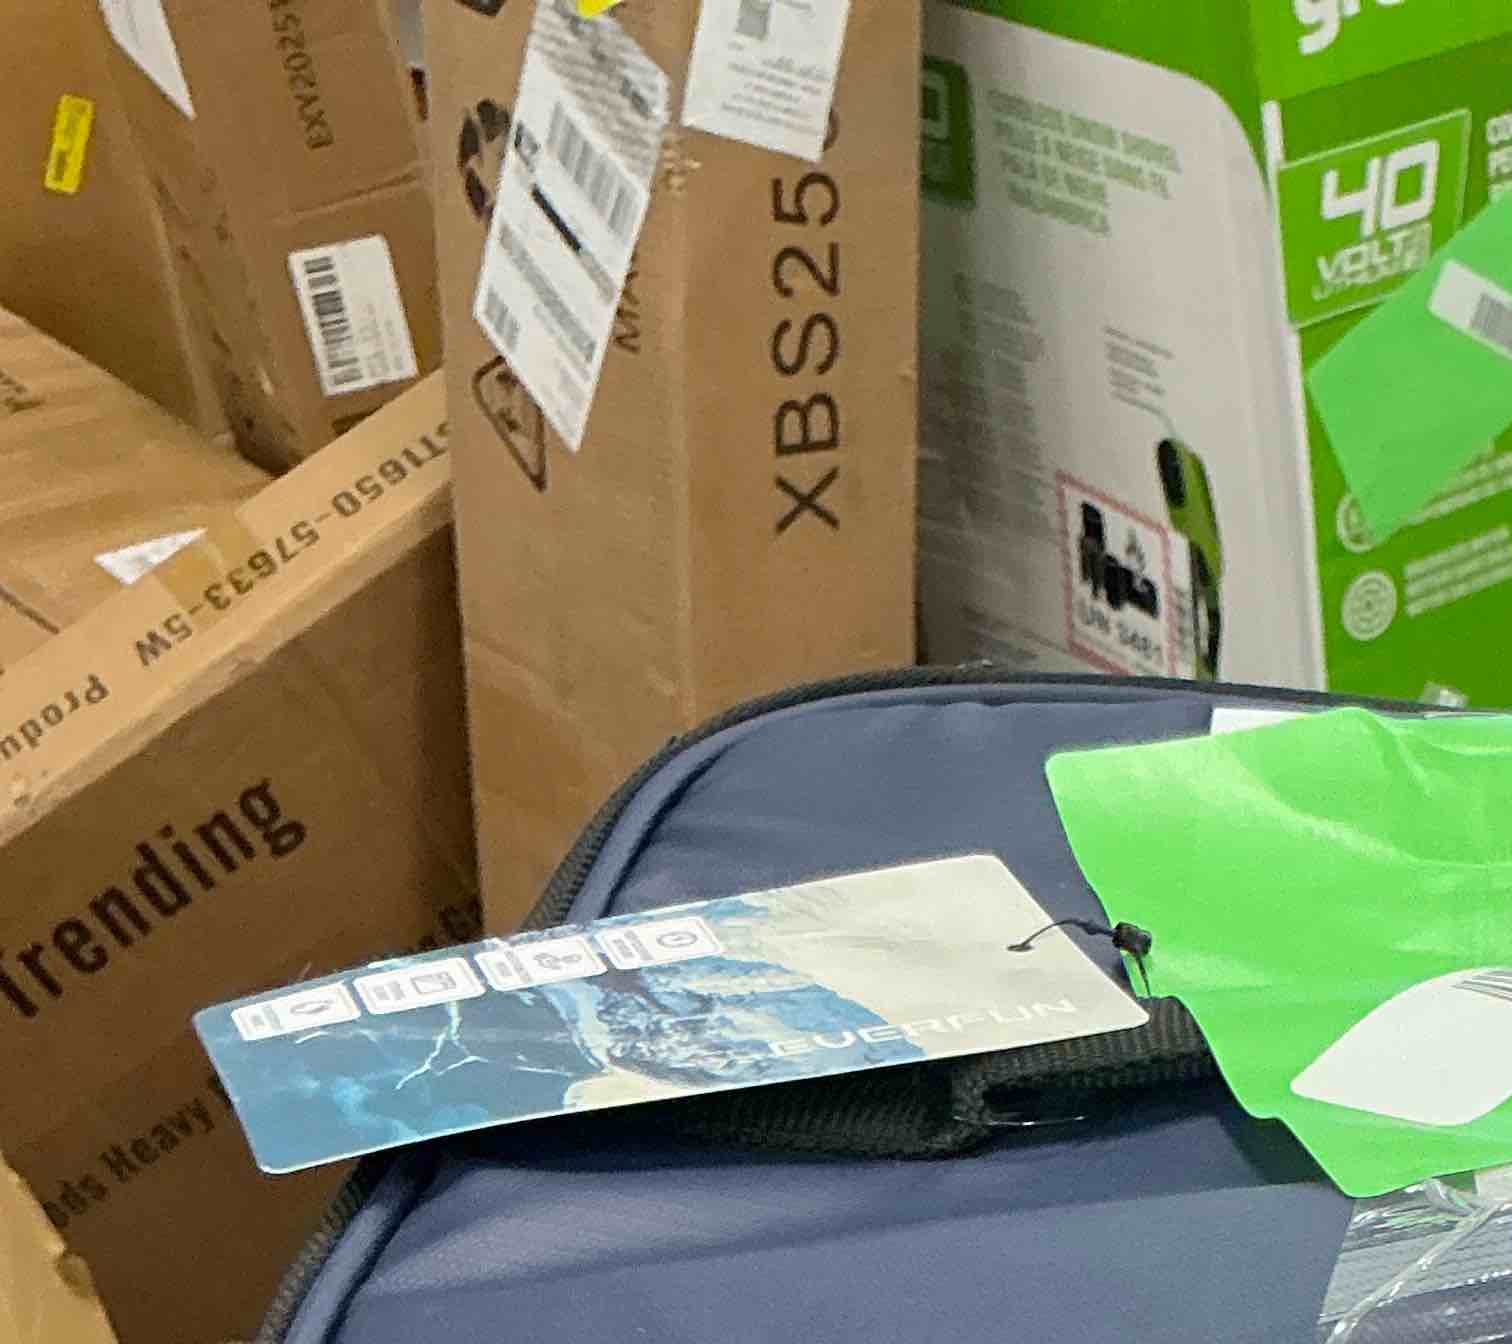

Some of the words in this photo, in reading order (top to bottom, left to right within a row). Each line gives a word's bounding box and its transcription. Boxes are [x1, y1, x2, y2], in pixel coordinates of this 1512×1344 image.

[1320, 139, 1440, 237] 40
[770, 170, 841, 535] XBS25
[767, 997, 1078, 1058] EVERFUN
[99, 1097, 216, 1184] Heavy
